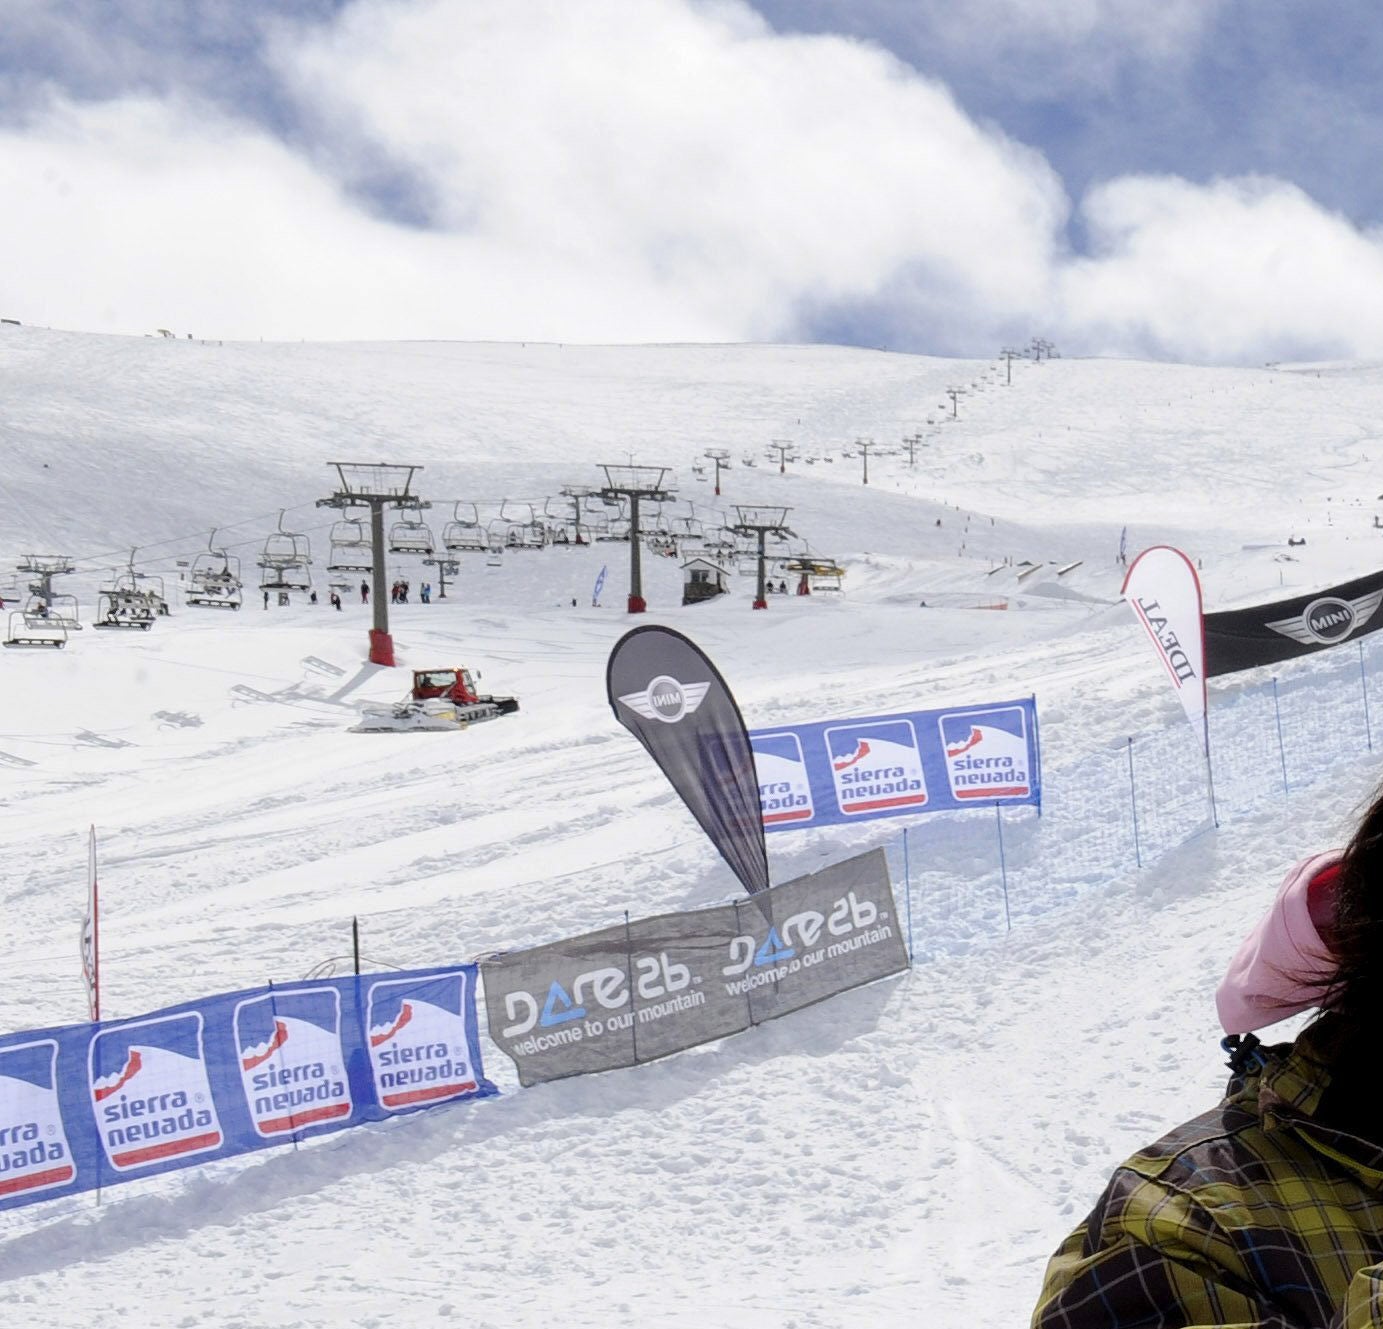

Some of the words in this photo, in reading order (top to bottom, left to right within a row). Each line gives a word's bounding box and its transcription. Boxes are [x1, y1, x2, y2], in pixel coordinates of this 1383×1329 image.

[1309, 609, 1352, 633] MINI
[840, 765, 905, 785] sierra
[953, 754, 1013, 772] sierra
[841, 777, 921, 800] nevada
[954, 767, 1026, 786] nevada
[759, 782, 791, 797] rra
[725, 966, 788, 997] welcome
[802, 947, 825, 968] our
[827, 923, 893, 958] mountain
[513, 1026, 583, 1058] welcome
[584, 1020, 604, 1038] to
[607, 1012, 636, 1032] our
[638, 989, 706, 1025] mountain
[378, 1042, 448, 1067] sierra
[252, 1061, 325, 1092] sierra
[380, 1061, 467, 1089] nevada
[103, 1090, 188, 1124] sierra
[255, 1079, 345, 1115] nevada
[0, 1122, 39, 1147] rra
[107, 1108, 213, 1148] nevada
